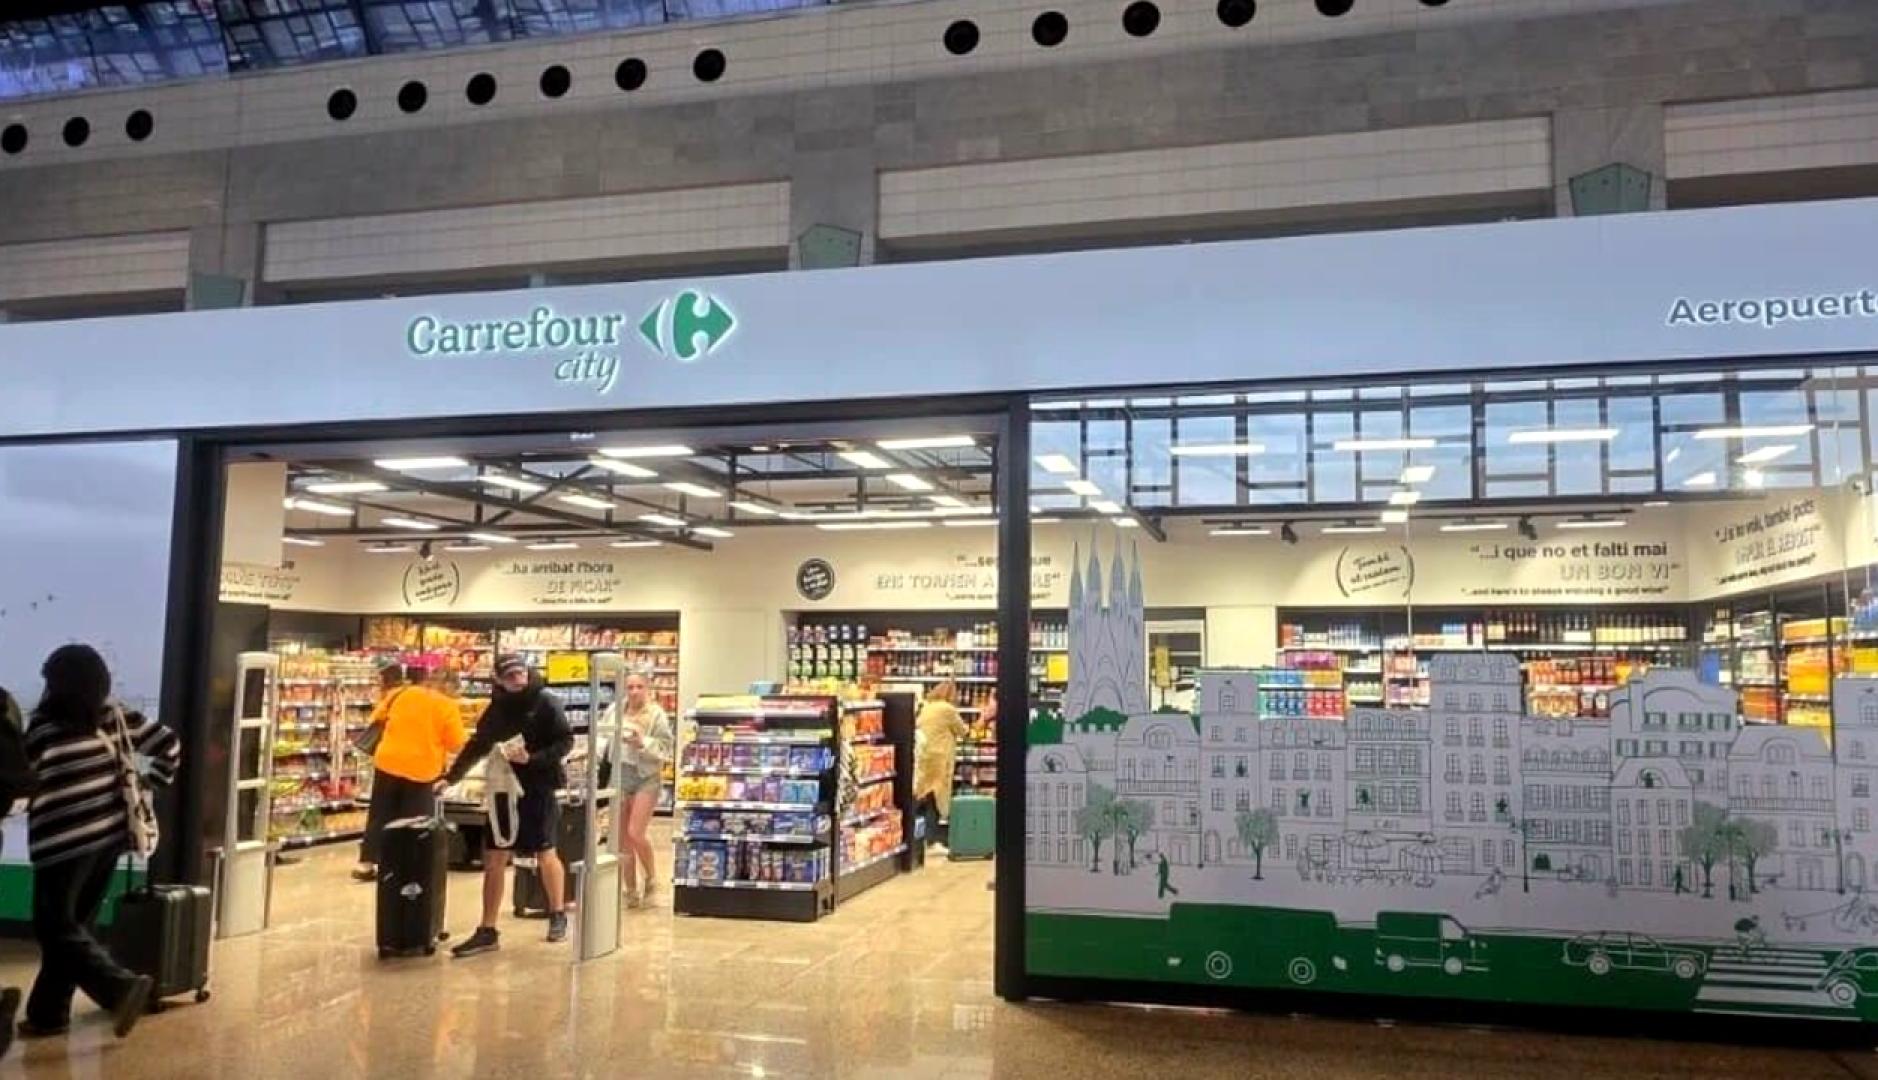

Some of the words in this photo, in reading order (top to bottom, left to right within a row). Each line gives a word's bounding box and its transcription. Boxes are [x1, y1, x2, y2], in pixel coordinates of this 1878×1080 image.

[1669, 289, 1878, 326] Aeropuert
[407, 306, 623, 354] Carrefour
[553, 350, 619, 392] city
[1504, 547, 1536, 561] que
[1542, 547, 1566, 558] no
[1571, 544, 1588, 557] et
[1594, 542, 1628, 557] falti
[1633, 541, 1667, 556] mai
[1560, 563, 1589, 581] UN
[1598, 562, 1642, 580] BON
